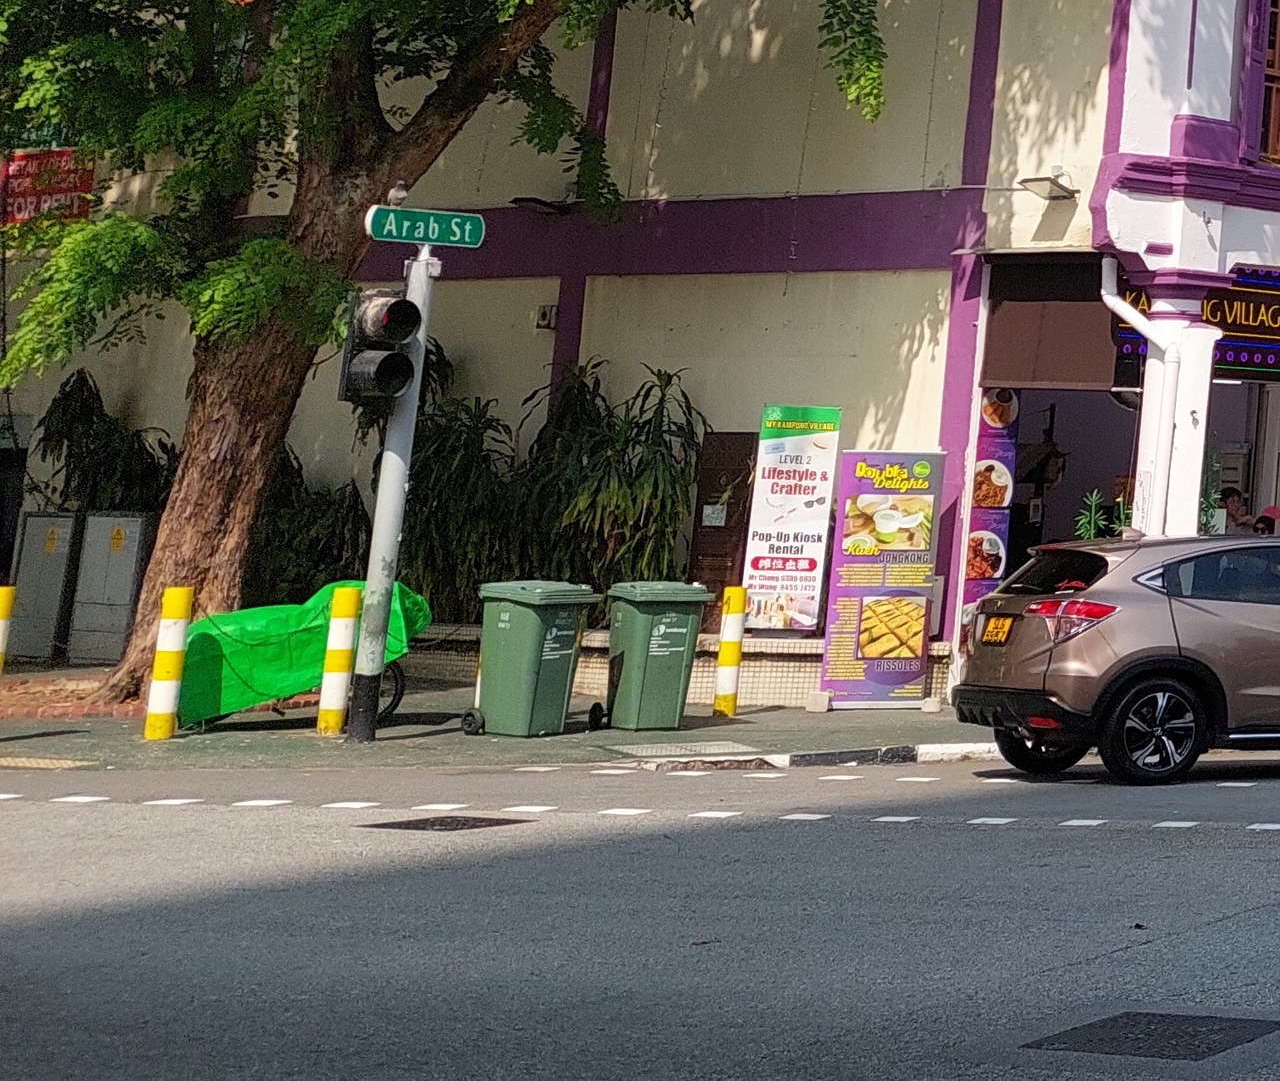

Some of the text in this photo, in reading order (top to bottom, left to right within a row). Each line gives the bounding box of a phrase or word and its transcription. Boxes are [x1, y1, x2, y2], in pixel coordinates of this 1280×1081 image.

[383, 212, 472, 242] Arab St
[779, 455, 812, 464] LEVEL 2
[761, 467, 828, 482] Lifestyle &
[771, 482, 817, 495] Crafter
[873, 478, 929, 492] Delights
[752, 531, 823, 543] Pop-Up Kiosk
[768, 544, 804, 555] Rental
[878, 553, 929, 563] JONGKONG
[875, 660, 920, 671] RISSOLES
